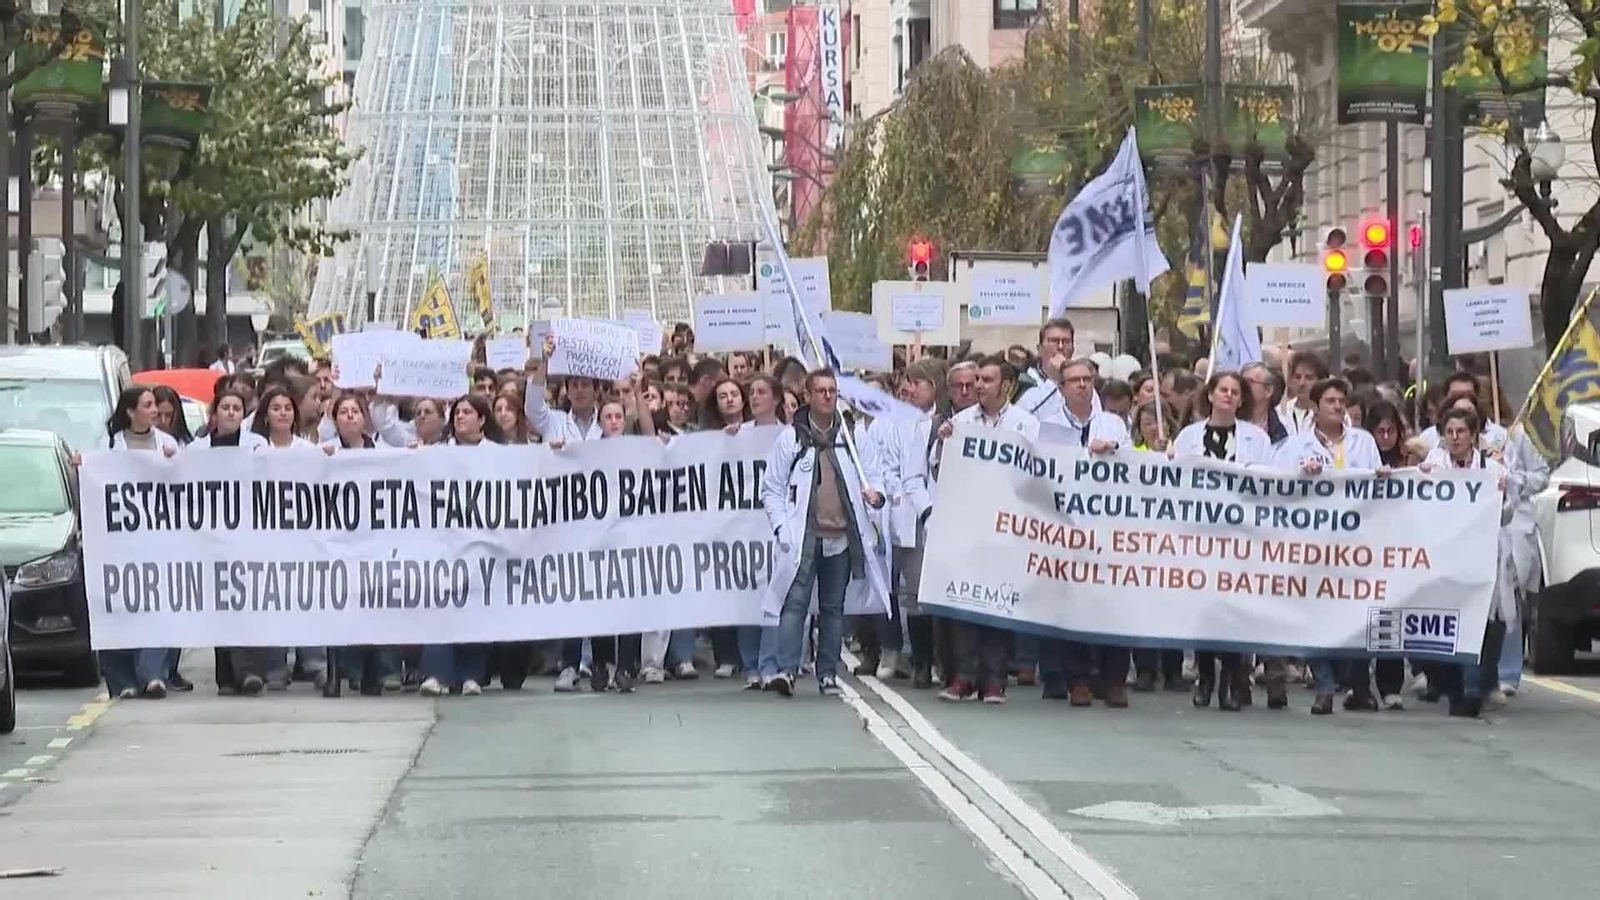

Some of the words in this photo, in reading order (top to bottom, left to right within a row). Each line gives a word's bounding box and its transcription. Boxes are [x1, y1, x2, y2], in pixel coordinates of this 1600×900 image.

[1355, 19, 1416, 35] MAGO
[1378, 33, 1413, 53] OZ
[566, 350, 598, 365] PAGAN
[602, 356, 622, 367] CON
[962, 436, 1064, 483] EUSKADI,
[1074, 461, 1130, 484] POR
[1139, 464, 1182, 487] UN
[1191, 467, 1335, 498] ESTATUTO
[1465, 481, 1482, 503] Y
[105, 480, 241, 533] ESTATUTU
[252, 480, 360, 532] MEDIKO
[370, 479, 421, 531] ETA
[430, 470, 608, 530] FAKULTATIBO
[618, 463, 707, 518] BATEN
[718, 459, 767, 510] ALD
[1054, 491, 1245, 526] FACULTATIVO
[1254, 505, 1361, 531] PROPIO
[995, 511, 1103, 555] EUSKADI,
[1112, 530, 1251, 560] ESTATUTU
[1262, 540, 1373, 568] MEDIKO
[1383, 547, 1431, 570] ETA
[103, 561, 160, 613] POR
[168, 561, 203, 612] UN
[214, 559, 348, 612] ESTATUTO
[359, 548, 469, 609] MÉDICO
[479, 557, 496, 606] Y
[505, 543, 684, 605] FACULTATIVO
[693, 540, 773, 592] PROPI
[1027, 553, 1207, 590] FAKULTATIBO
[1217, 572, 1307, 598] BATEN
[1316, 577, 1387, 600] ALDE
[1404, 614, 1457, 637] SME
